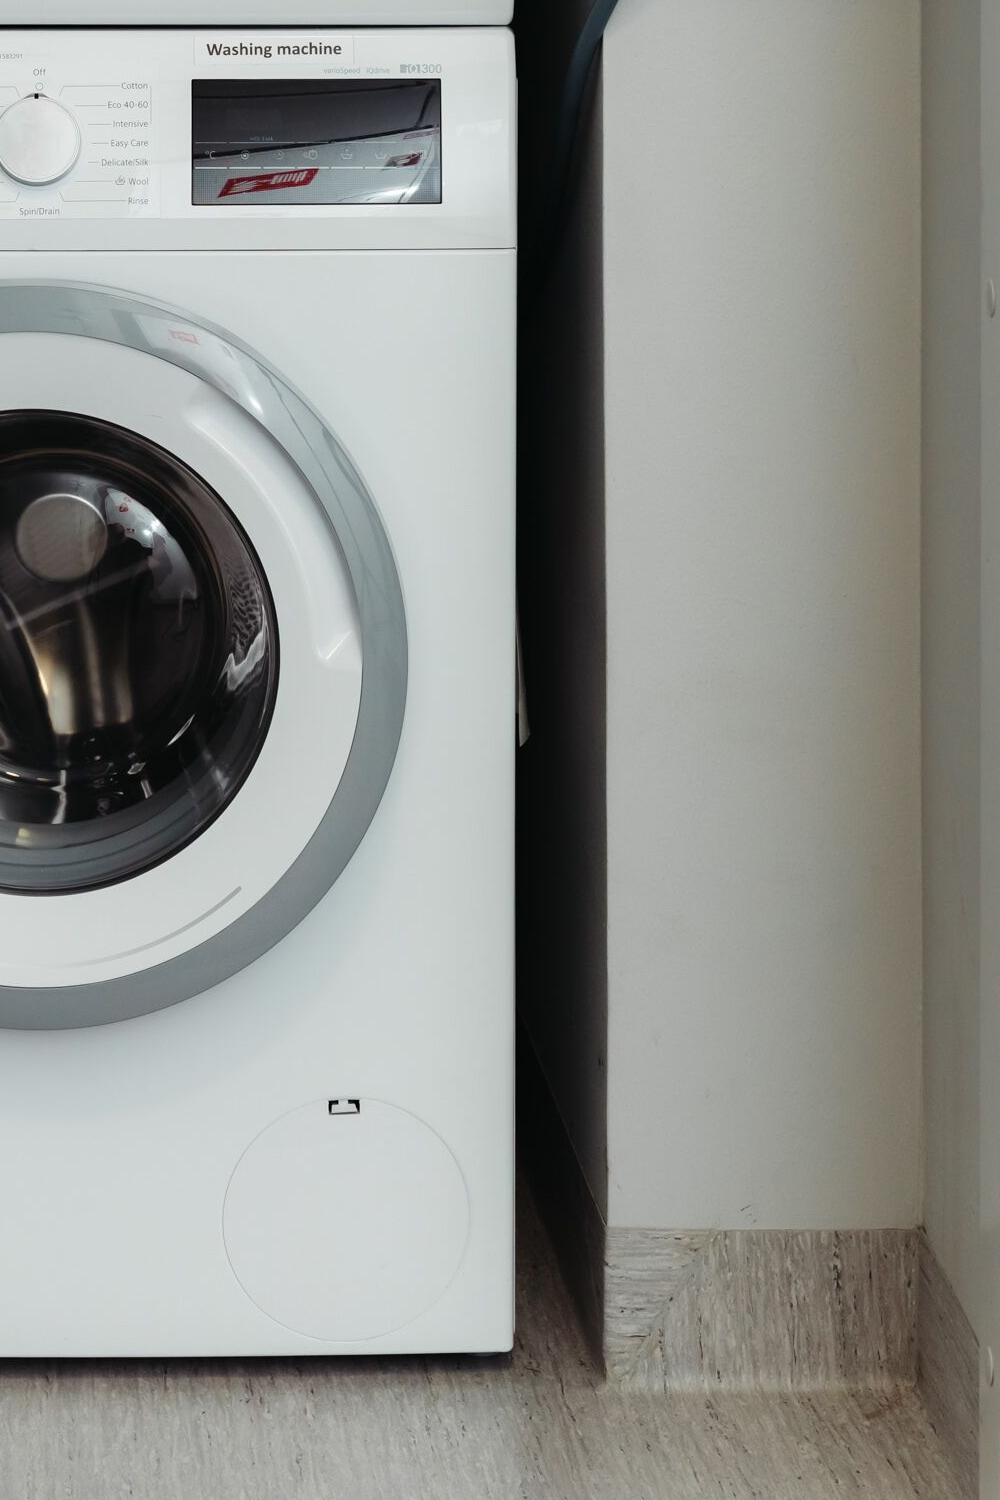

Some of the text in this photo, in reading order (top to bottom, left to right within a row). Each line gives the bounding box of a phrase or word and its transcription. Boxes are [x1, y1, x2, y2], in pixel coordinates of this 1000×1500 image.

[206, 41, 342, 59] Washing machine
[32, 67, 46, 77] Off
[121, 82, 149, 90] Cotton
[107, 100, 122, 109] Eco
[112, 120, 149, 128] Intensive
[110, 138, 149, 149] Easy Care
[101, 158, 149, 167] Delicate/Silk
[128, 177, 149, 186] Wool
[127, 196, 149, 205] Rinse
[19, 206, 60, 217] Spin/Drain
